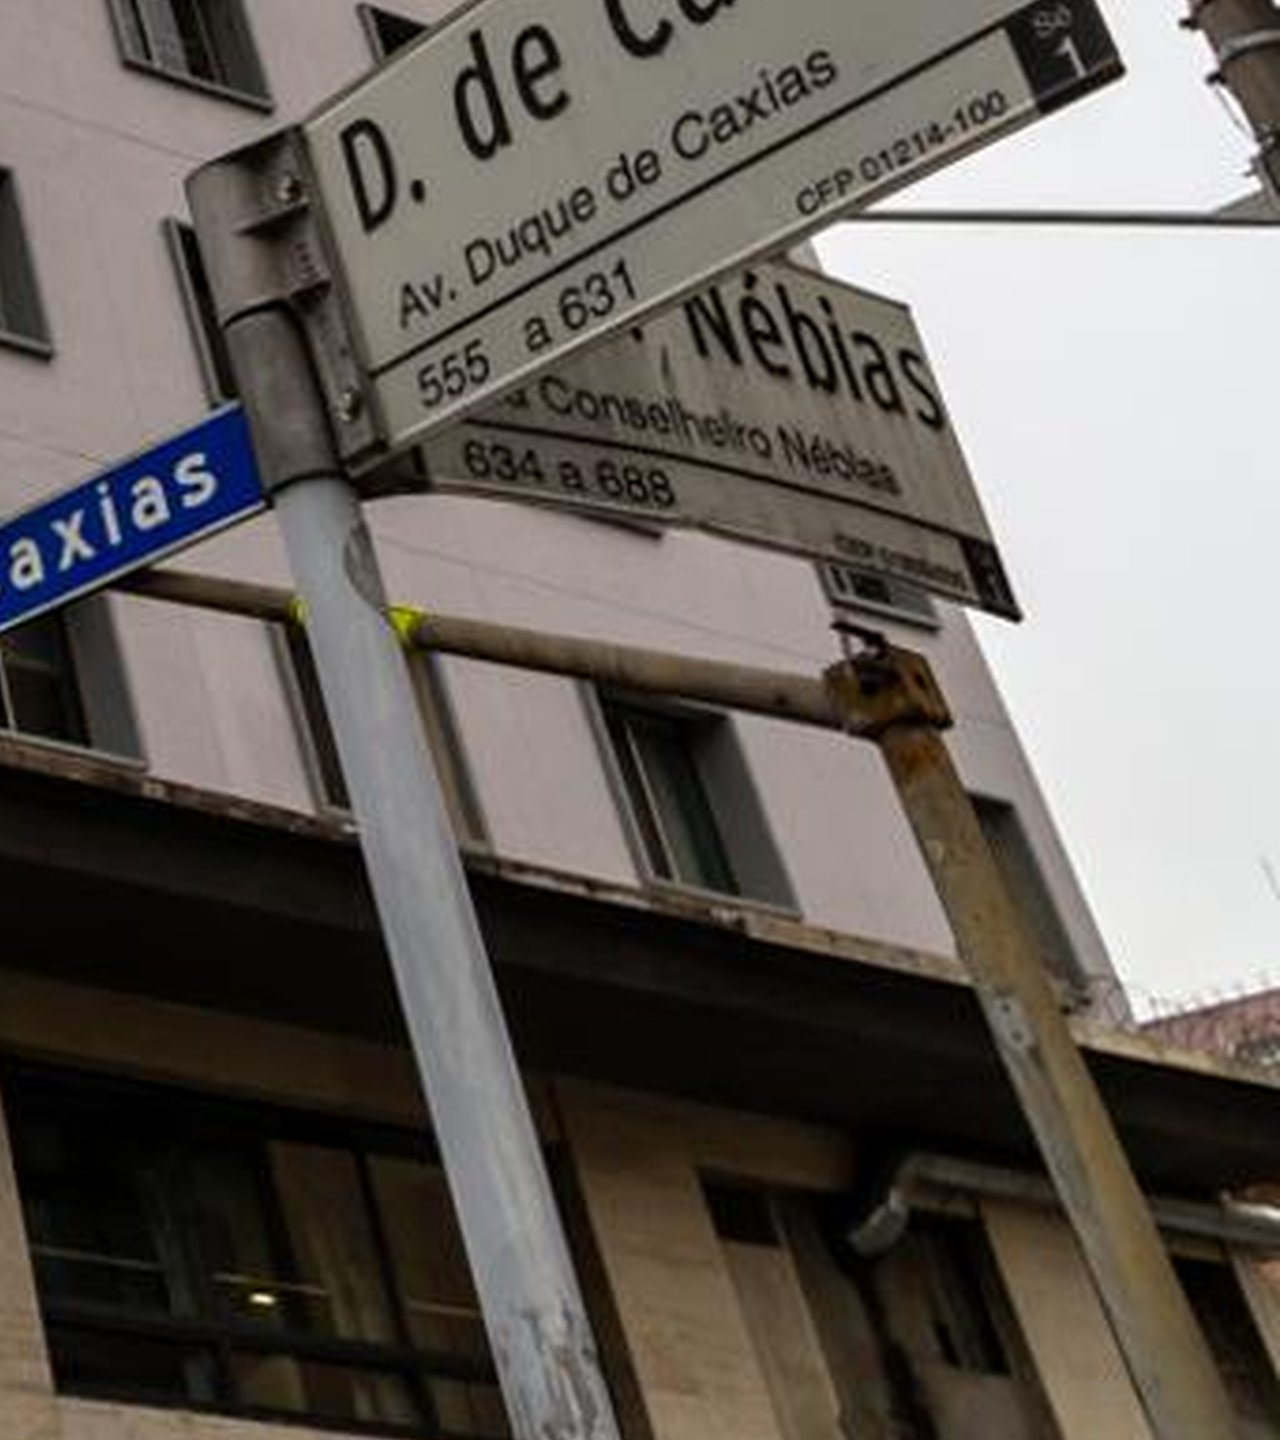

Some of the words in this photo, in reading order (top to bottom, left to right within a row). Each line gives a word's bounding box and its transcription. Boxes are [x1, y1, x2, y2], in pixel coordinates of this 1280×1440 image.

[339, 117, 427, 234] D.
[452, 20, 571, 163] de
[1054, 35, 1089, 80] 1
[399, 273, 458, 330] Av.
[464, 165, 597, 287] Duque
[606, 146, 662, 207] de
[671, 47, 838, 163] Caxias
[858, 90, 1007, 183] 01214-100
[416, 337, 490, 409] 555
[523, 317, 553, 353] a
[557, 258, 637, 330] 631
[682, 272, 945, 432] Nébias
[463, 439, 545, 484] 634
[558, 460, 585, 491] a
